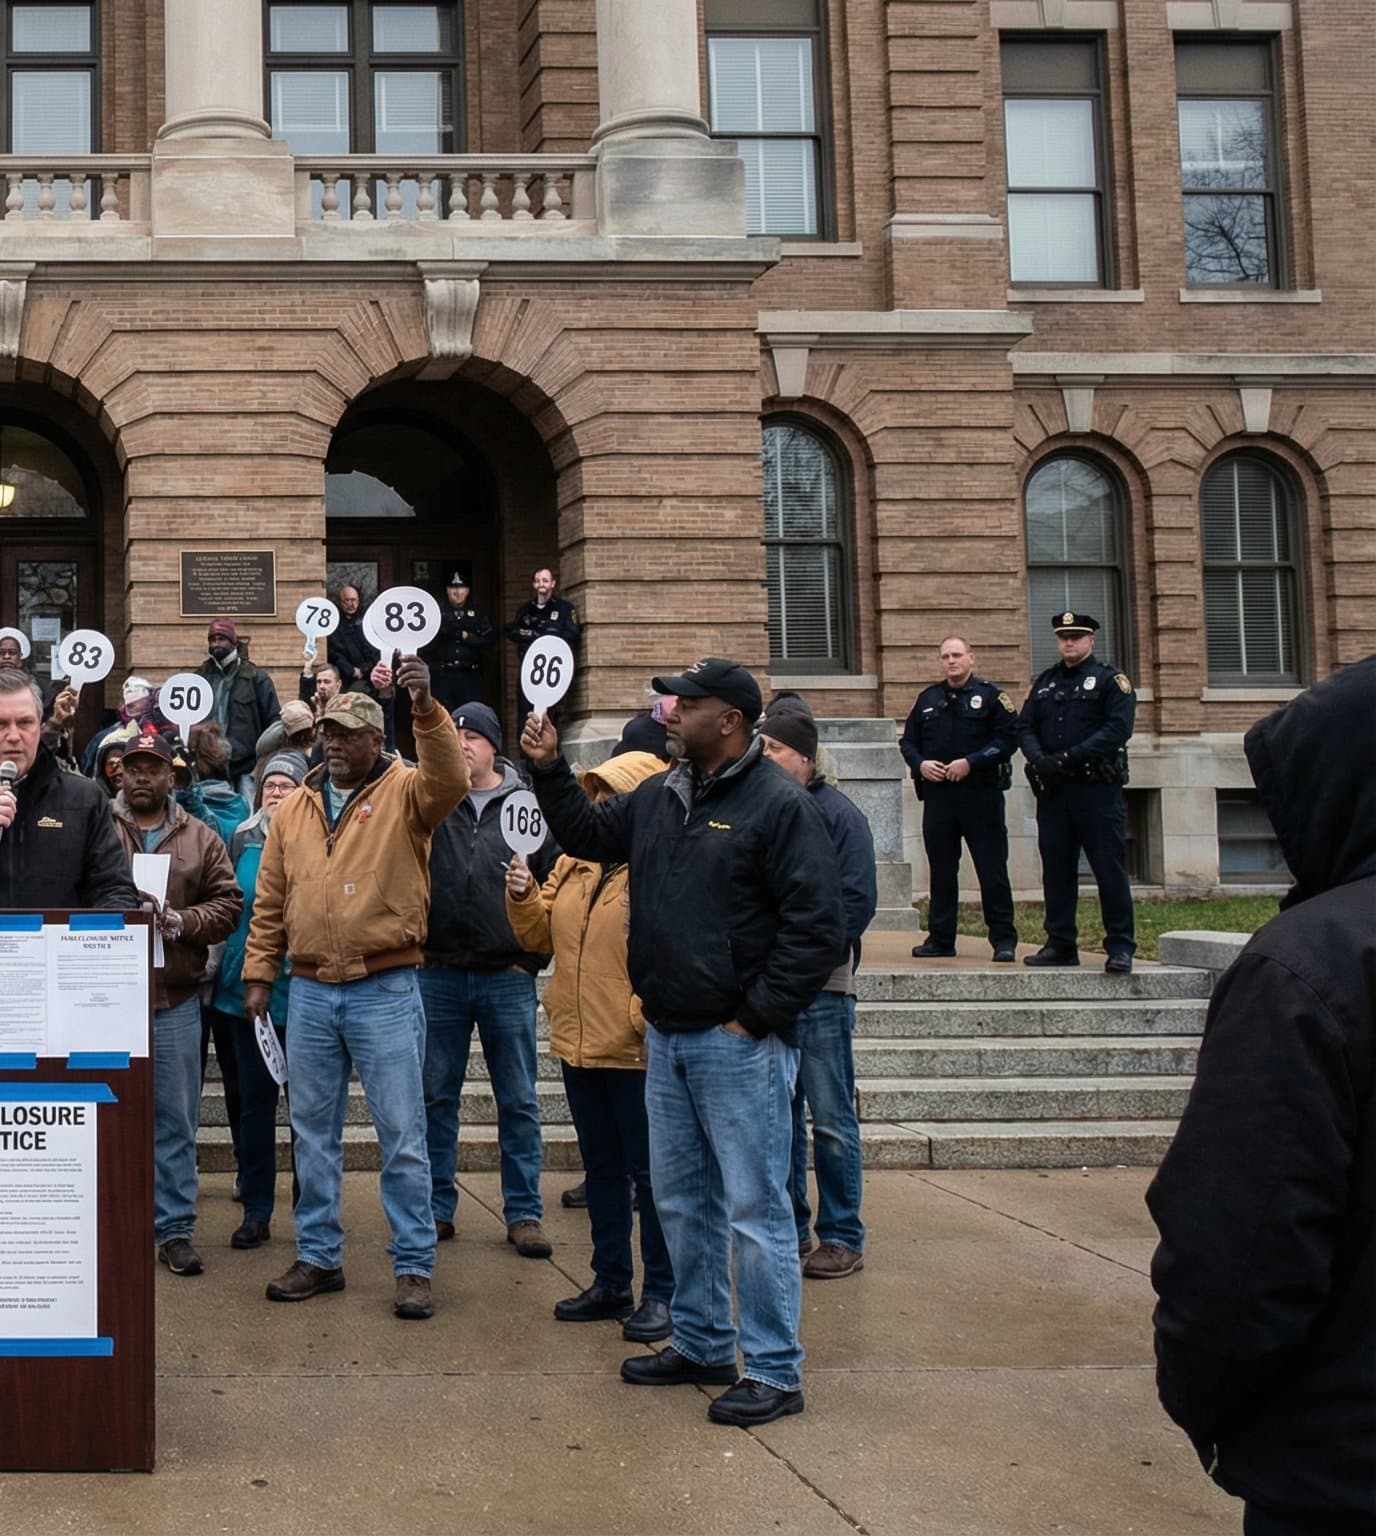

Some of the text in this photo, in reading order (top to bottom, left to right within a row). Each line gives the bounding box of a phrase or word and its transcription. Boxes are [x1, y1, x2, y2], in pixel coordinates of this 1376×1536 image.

[306, 605, 331, 628] 78
[385, 602, 426, 632] 83
[69, 642, 102, 669] 83
[530, 654, 562, 688] 86
[169, 687, 201, 711] 50
[506, 804, 541, 837] 168
